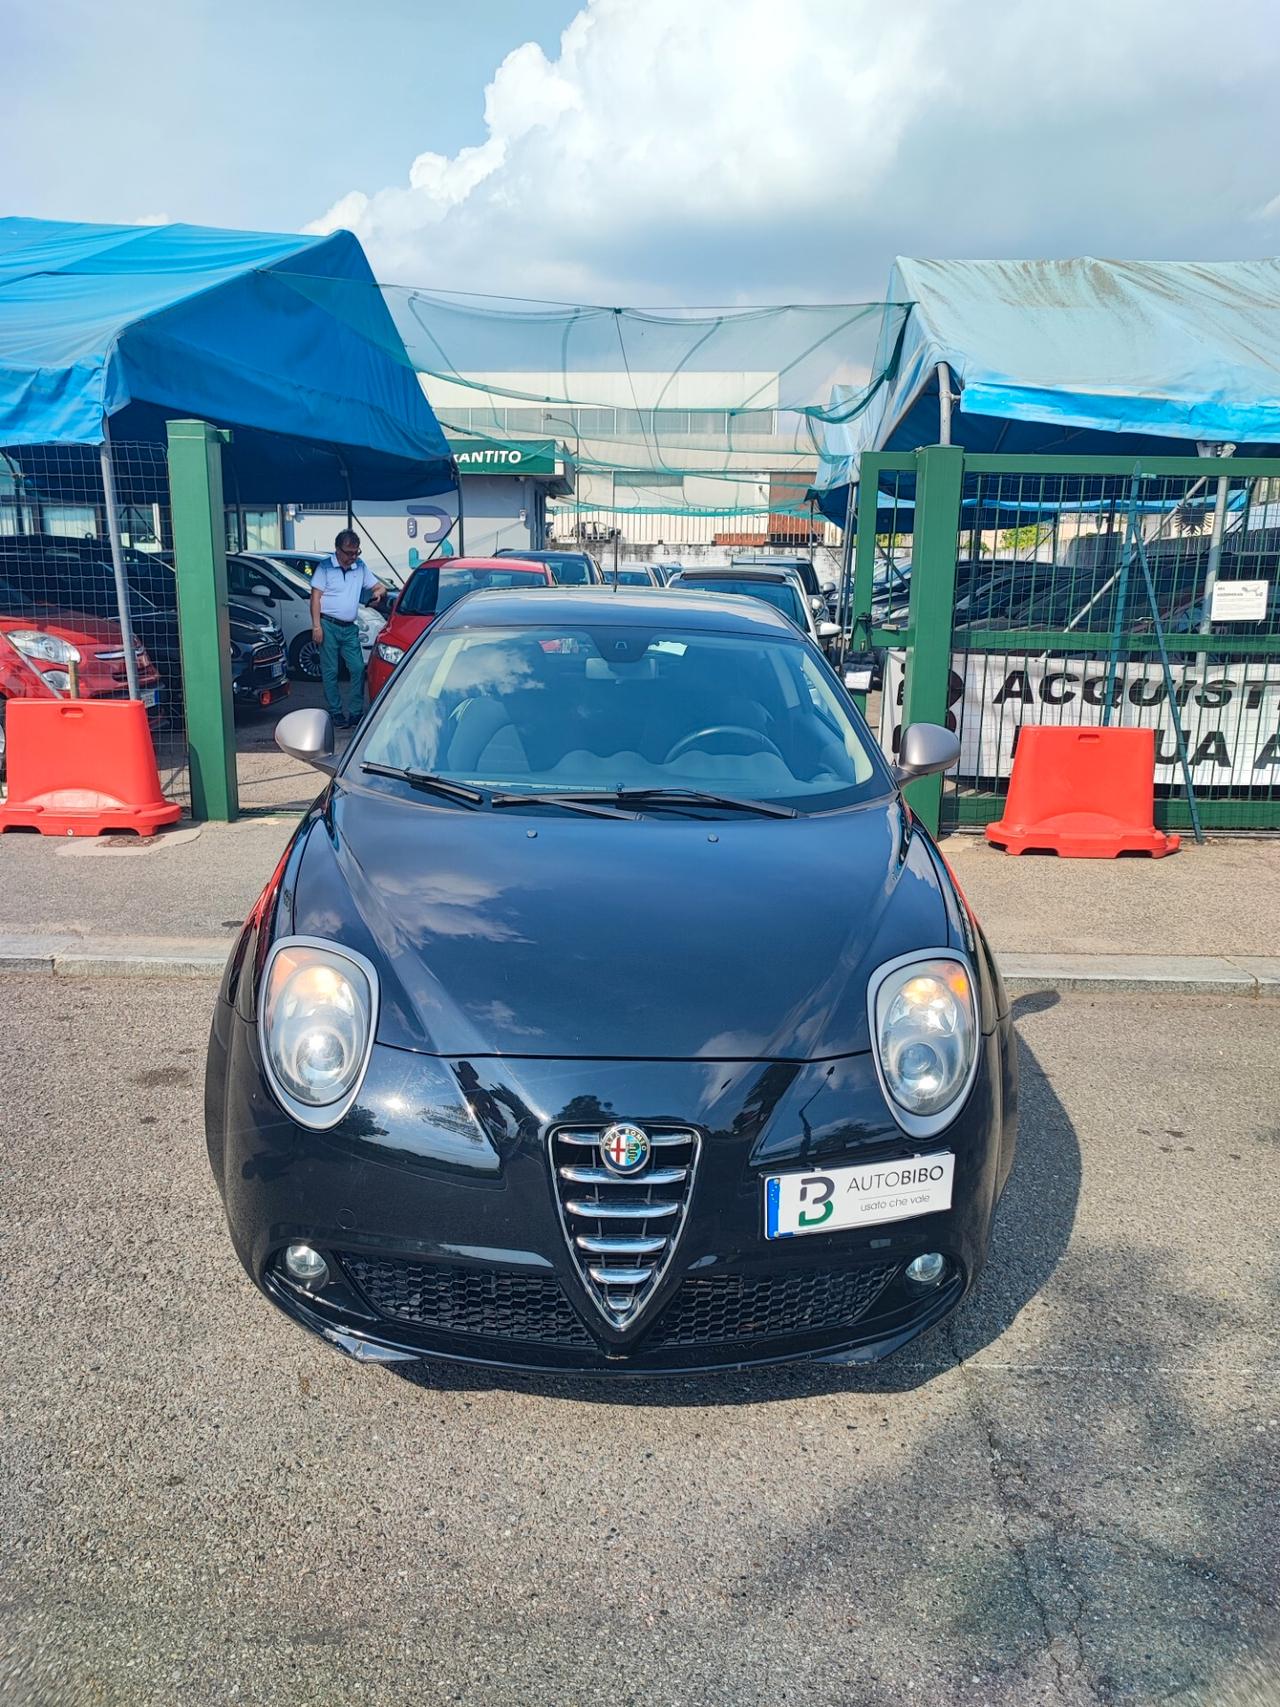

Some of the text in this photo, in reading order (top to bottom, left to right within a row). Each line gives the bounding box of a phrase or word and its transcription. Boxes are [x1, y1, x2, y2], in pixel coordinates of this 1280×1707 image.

[992, 670, 1280, 710] ACQUIST
[1152, 728, 1232, 768] UA
[846, 1165, 944, 1193] AUTOBIBO
[860, 1194, 931, 1212] usato che vale
